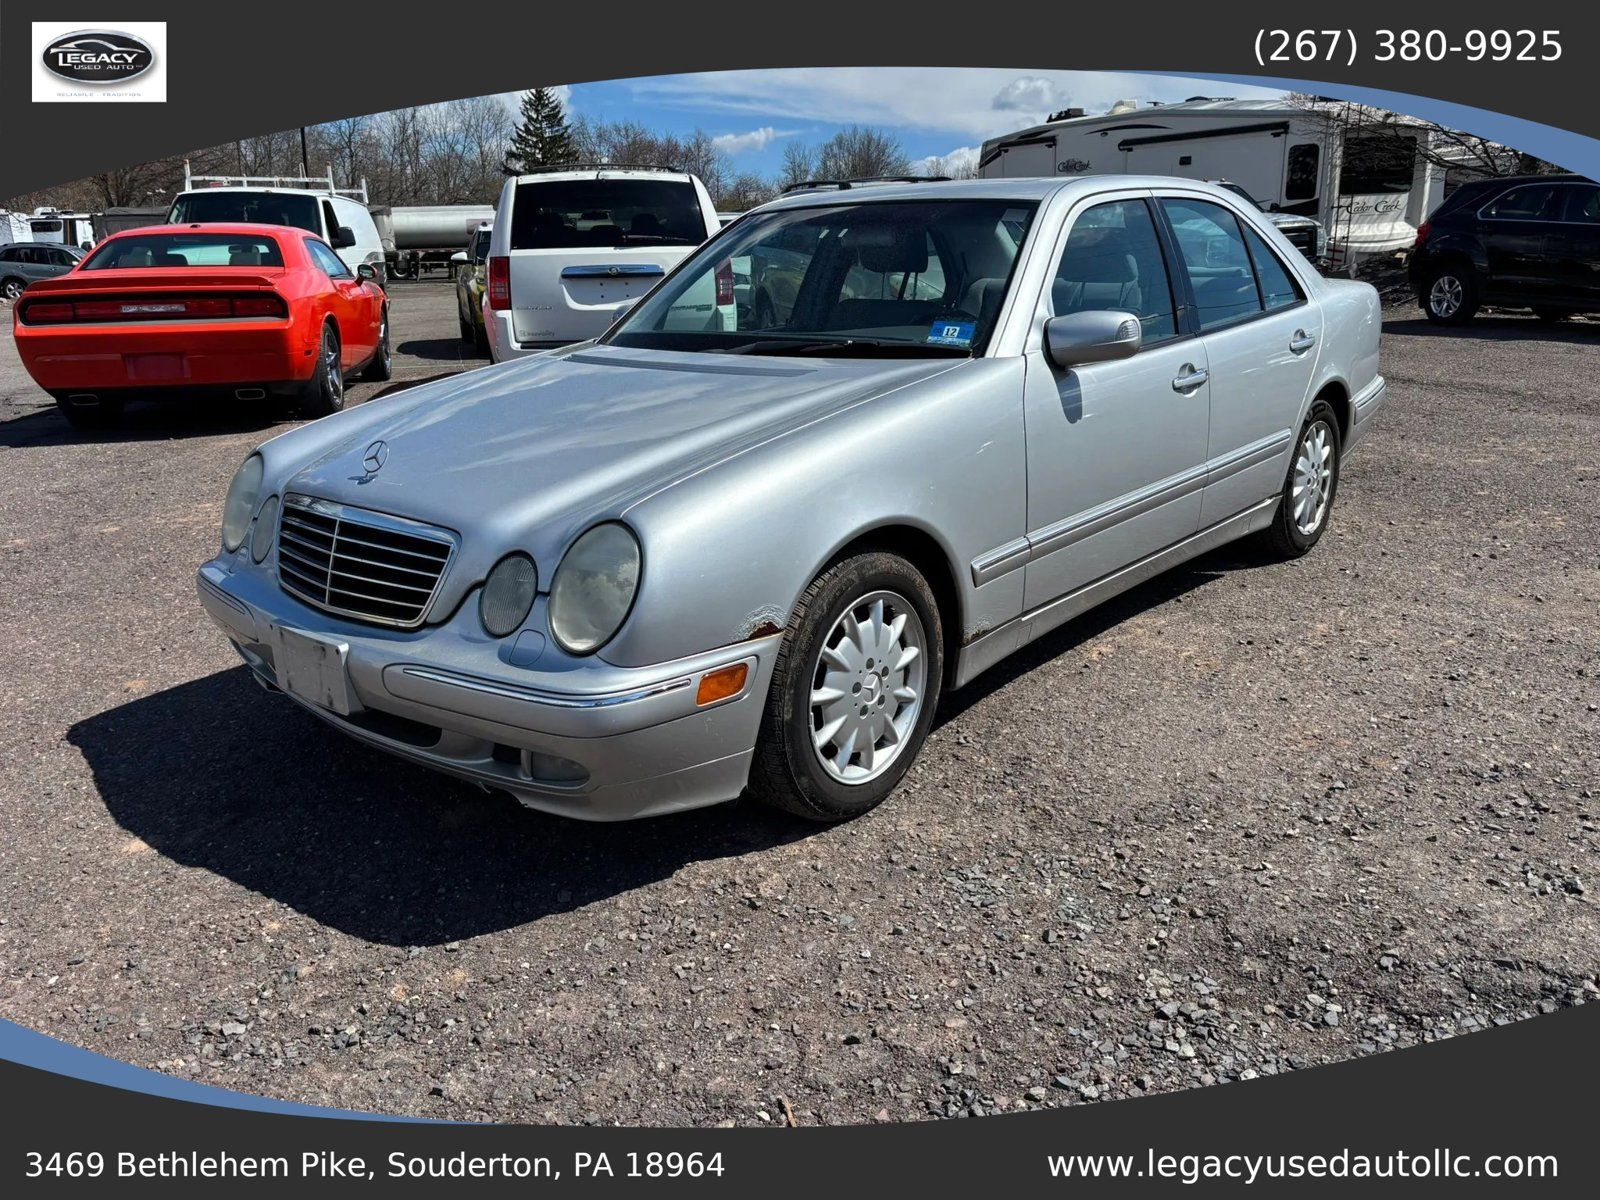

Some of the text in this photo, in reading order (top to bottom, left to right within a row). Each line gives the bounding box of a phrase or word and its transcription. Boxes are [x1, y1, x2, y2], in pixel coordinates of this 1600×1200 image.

[1346, 199, 1405, 214] Cedar Creek
[944, 327, 958, 337] 12
